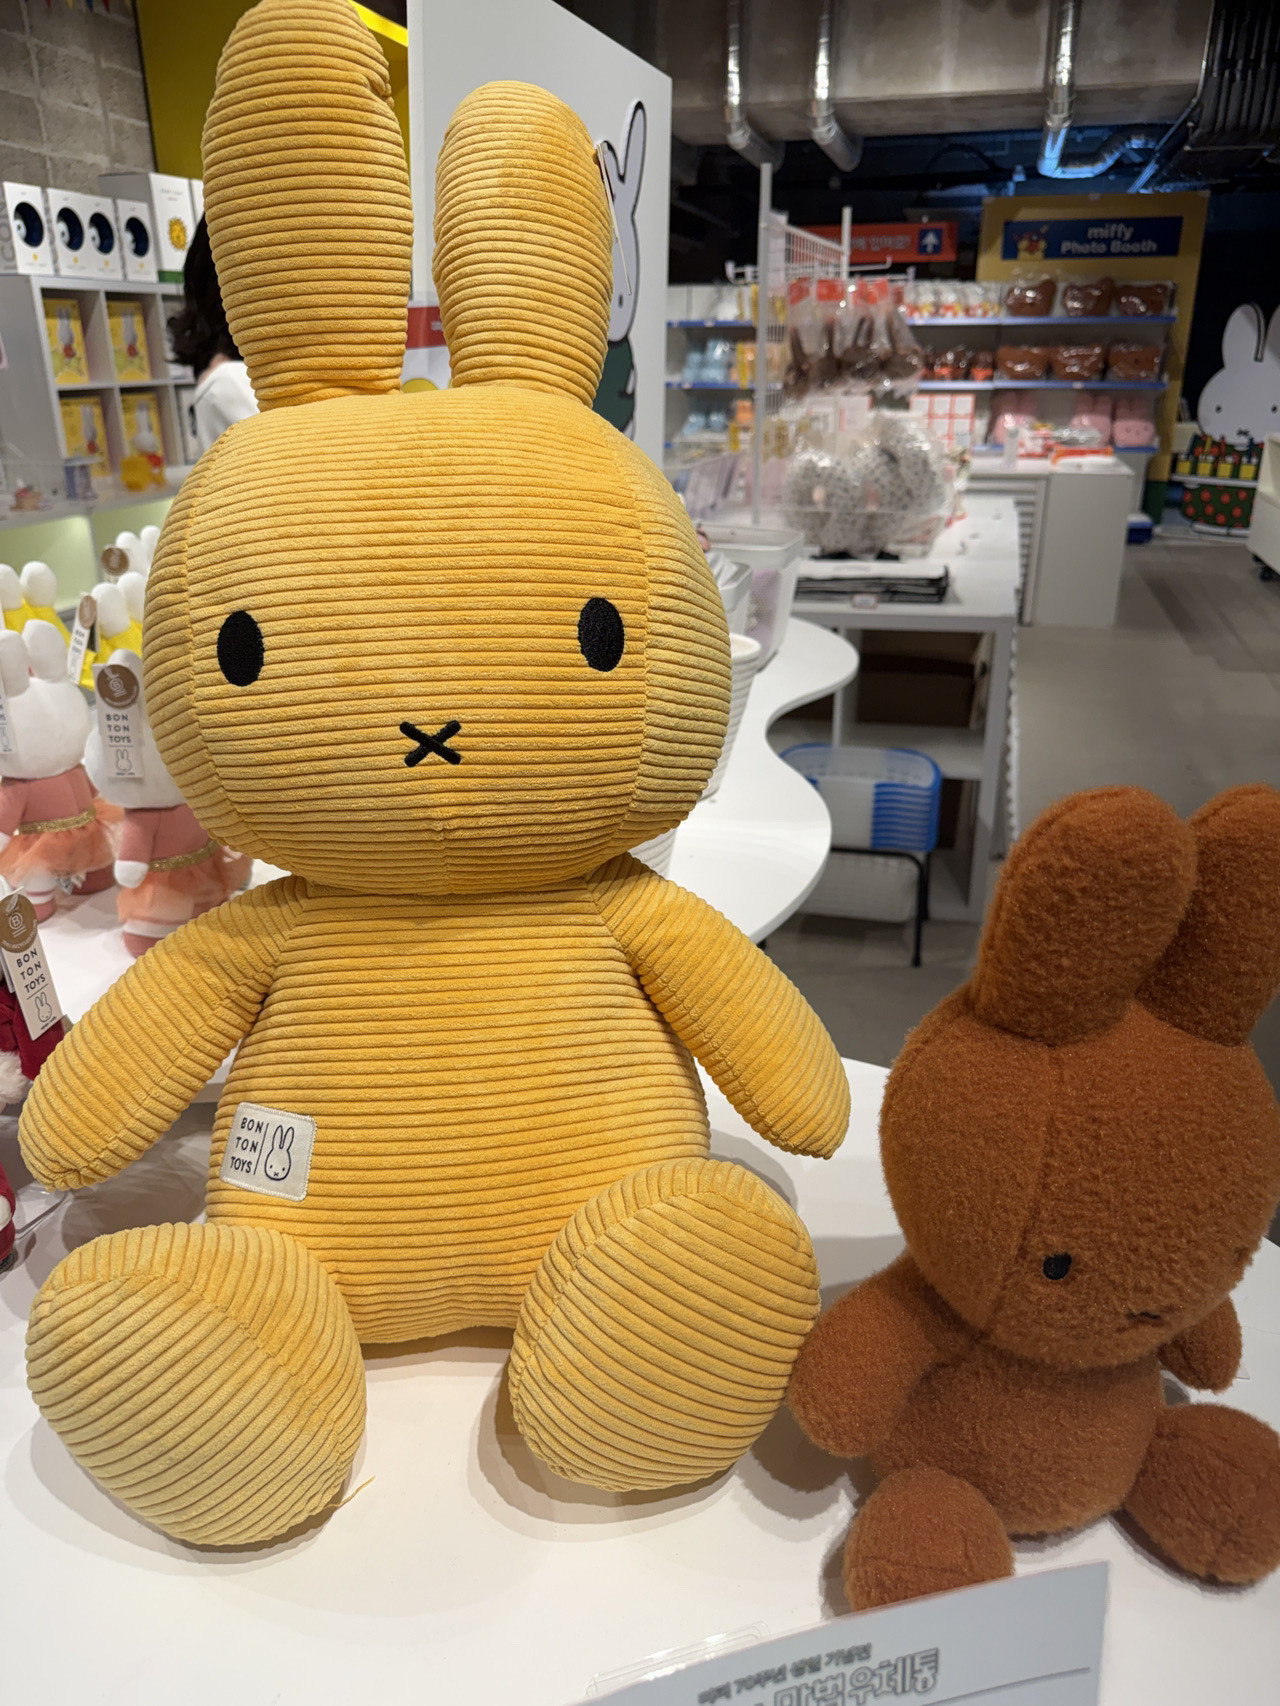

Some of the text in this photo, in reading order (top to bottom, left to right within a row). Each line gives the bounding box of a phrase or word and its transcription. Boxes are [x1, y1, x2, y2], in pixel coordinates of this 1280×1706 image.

[1087, 222, 1134, 241] miffy
[1060, 239, 1158, 254] Photo Booth
[106, 713, 129, 722] BON
[106, 724, 130, 732] TON
[109, 735, 132, 744] TOYS
[16, 948, 38, 968] BON
[20, 961, 42, 981] TON
[24, 973, 46, 994] TOYS
[240, 1117, 264, 1133] BON
[235, 1136, 259, 1153] TON
[230, 1156, 253, 1174] TOYS
[734, 1663, 787, 1694] 70주년
